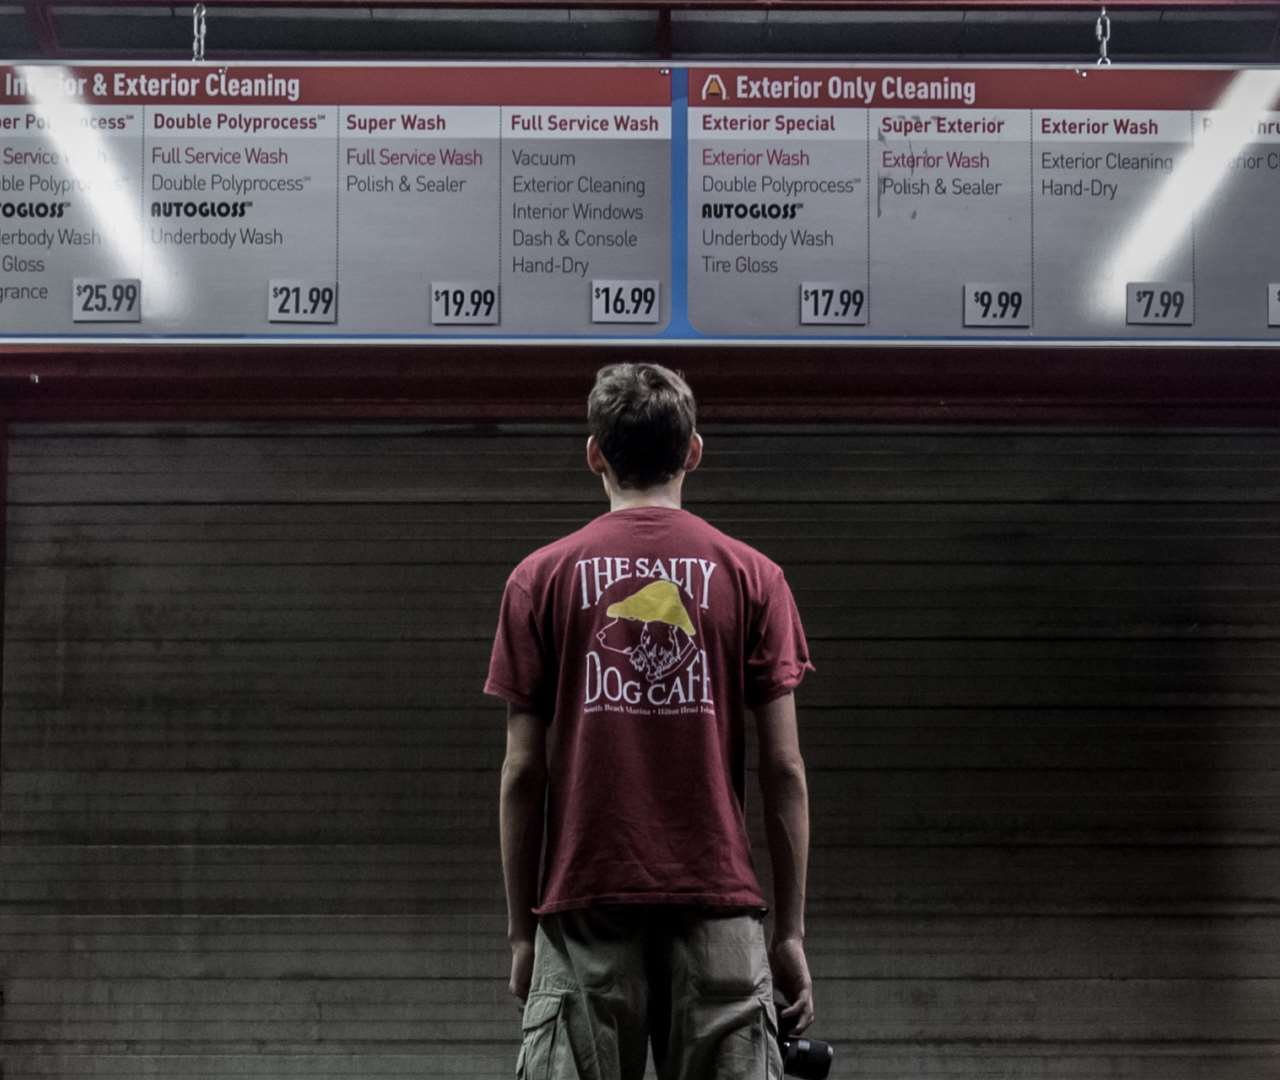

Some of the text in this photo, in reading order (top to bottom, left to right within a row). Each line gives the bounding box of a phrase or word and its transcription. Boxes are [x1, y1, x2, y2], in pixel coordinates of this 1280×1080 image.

[6, 73, 301, 102] Inor & Exterior Cleaning
[736, 76, 976, 105] Exterior Only Cleaning
[153, 113, 212, 130] Double
[346, 114, 447, 134] Super Wash
[511, 115, 659, 132] Full Service Wash
[702, 114, 836, 135] Exterior Special
[882, 117, 1005, 135] Super Exterior
[1041, 118, 1159, 135] Exterior Wash
[3, 148, 60, 164] Service
[152, 147, 289, 165] Full Service Wash
[346, 148, 482, 166] Full Service Wash
[512, 150, 576, 166] Vacuum
[702, 149, 810, 166] Exterior Wash
[882, 150, 990, 168] Exterior Wash
[1041, 152, 1103, 170] Exterior
[152, 174, 206, 192] Double
[346, 176, 467, 193] Polish & Sealer
[512, 176, 646, 198] Exterior Cleaning
[702, 176, 757, 194] Double
[882, 178, 1002, 196] Polish & Sealer
[1041, 180, 1118, 200] Hand-Dry
[512, 203, 644, 220] Interior Windows
[58, 229, 102, 246] Wash
[152, 228, 284, 249] Underbody Wash
[512, 230, 638, 248] Dash & Console
[702, 230, 834, 250] Underbody Wash
[2, 256, 46, 273] Gloss
[512, 257, 590, 278] Hand-Dry
[702, 256, 779, 274] Tire Gloss
[76, 284, 137, 312] $25.99
[272, 286, 334, 315] $21.99
[434, 289, 495, 317] $19.99
[594, 286, 656, 315] $16.99
[804, 289, 864, 317] $17.99
[974, 290, 1022, 319] $9.99
[1136, 290, 1185, 318] $7.99
[576, 556, 718, 610] THE SALTY
[584, 650, 642, 705] DOG
